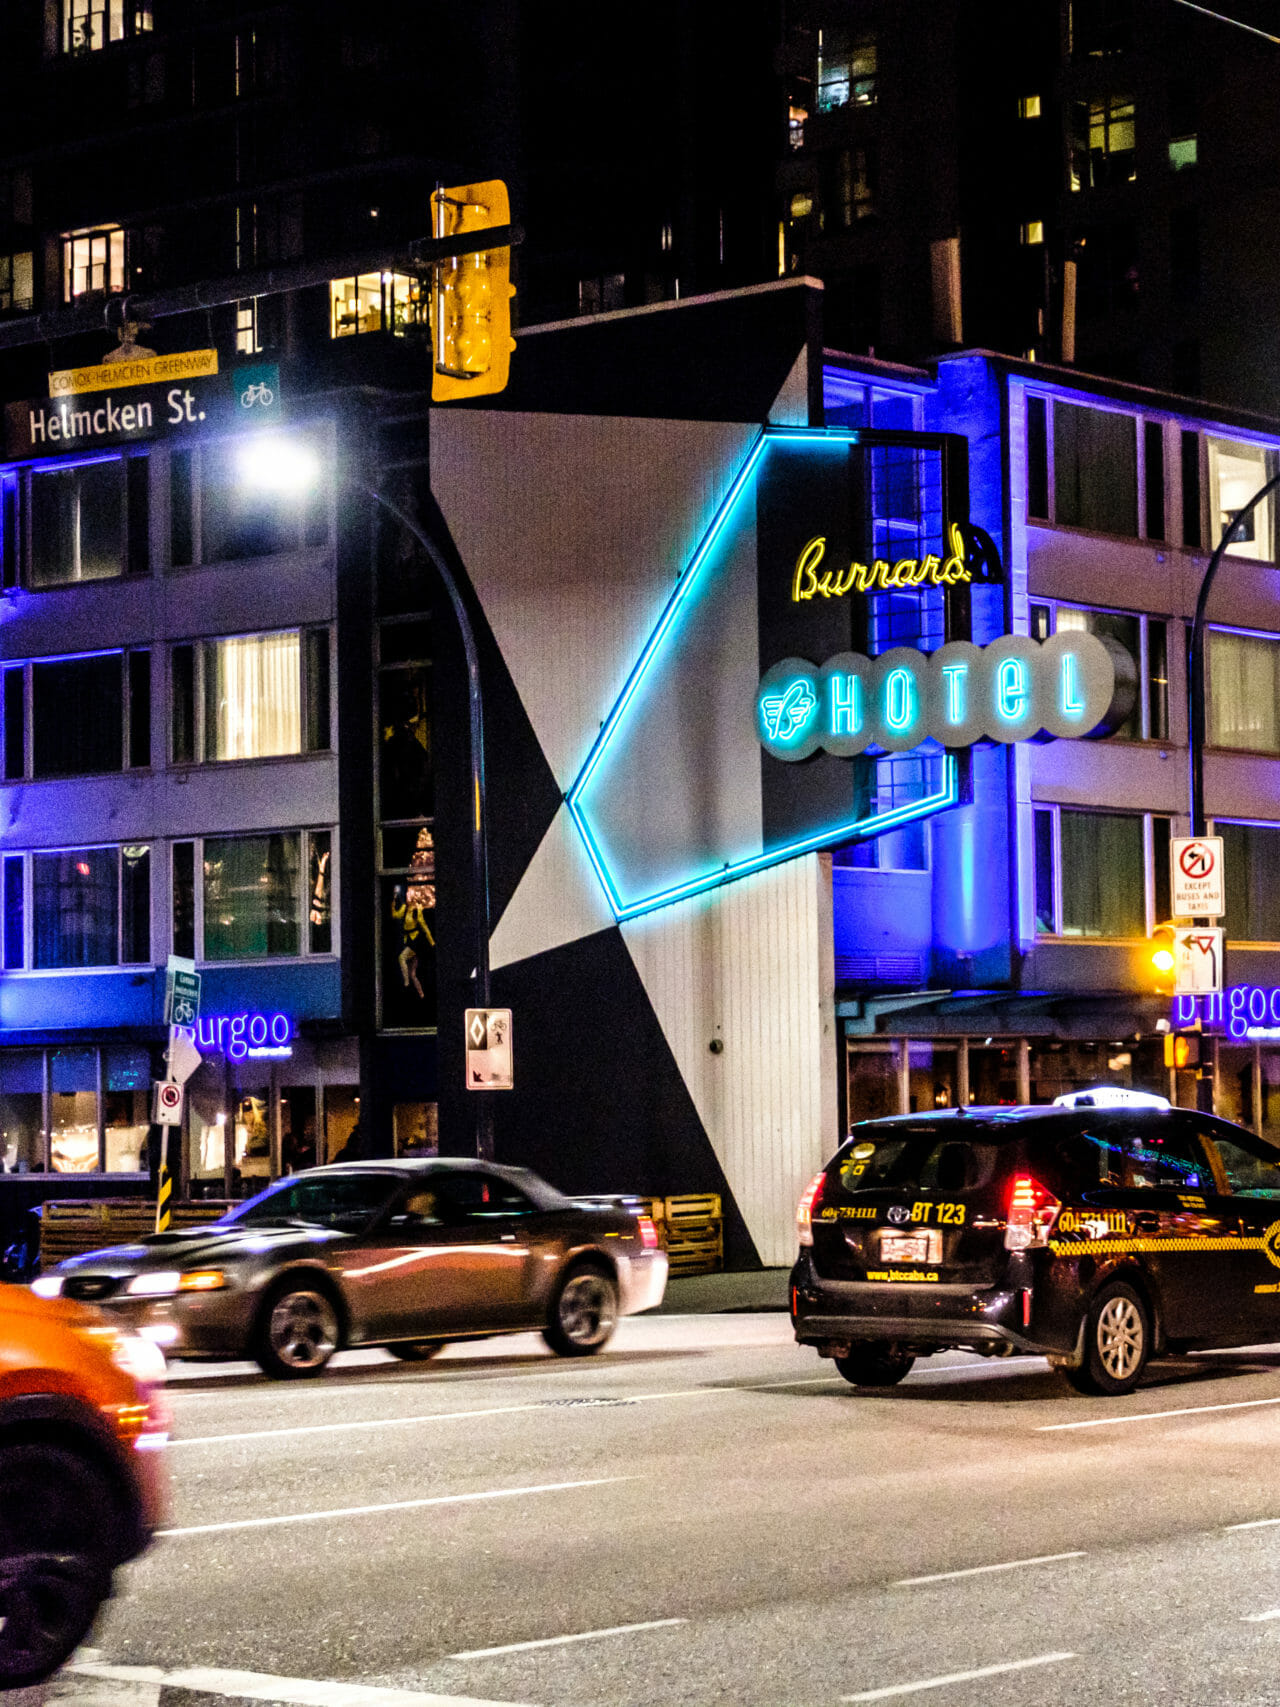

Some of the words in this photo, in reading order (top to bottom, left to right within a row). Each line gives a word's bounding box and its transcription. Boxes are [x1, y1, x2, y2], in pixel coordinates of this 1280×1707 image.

[154, 355, 212, 375] GREENWAY
[29, 397, 153, 444] Helmcken
[167, 389, 206, 424] St.
[792, 523, 973, 602] Burrard
[1176, 891, 1200, 901] BUSES
[1203, 891, 1220, 900] AND
[1184, 881, 1211, 891] EXCEPT
[177, 1014, 289, 1058] urgoo
[911, 1202, 933, 1223] BT
[936, 1203, 966, 1225] 123
